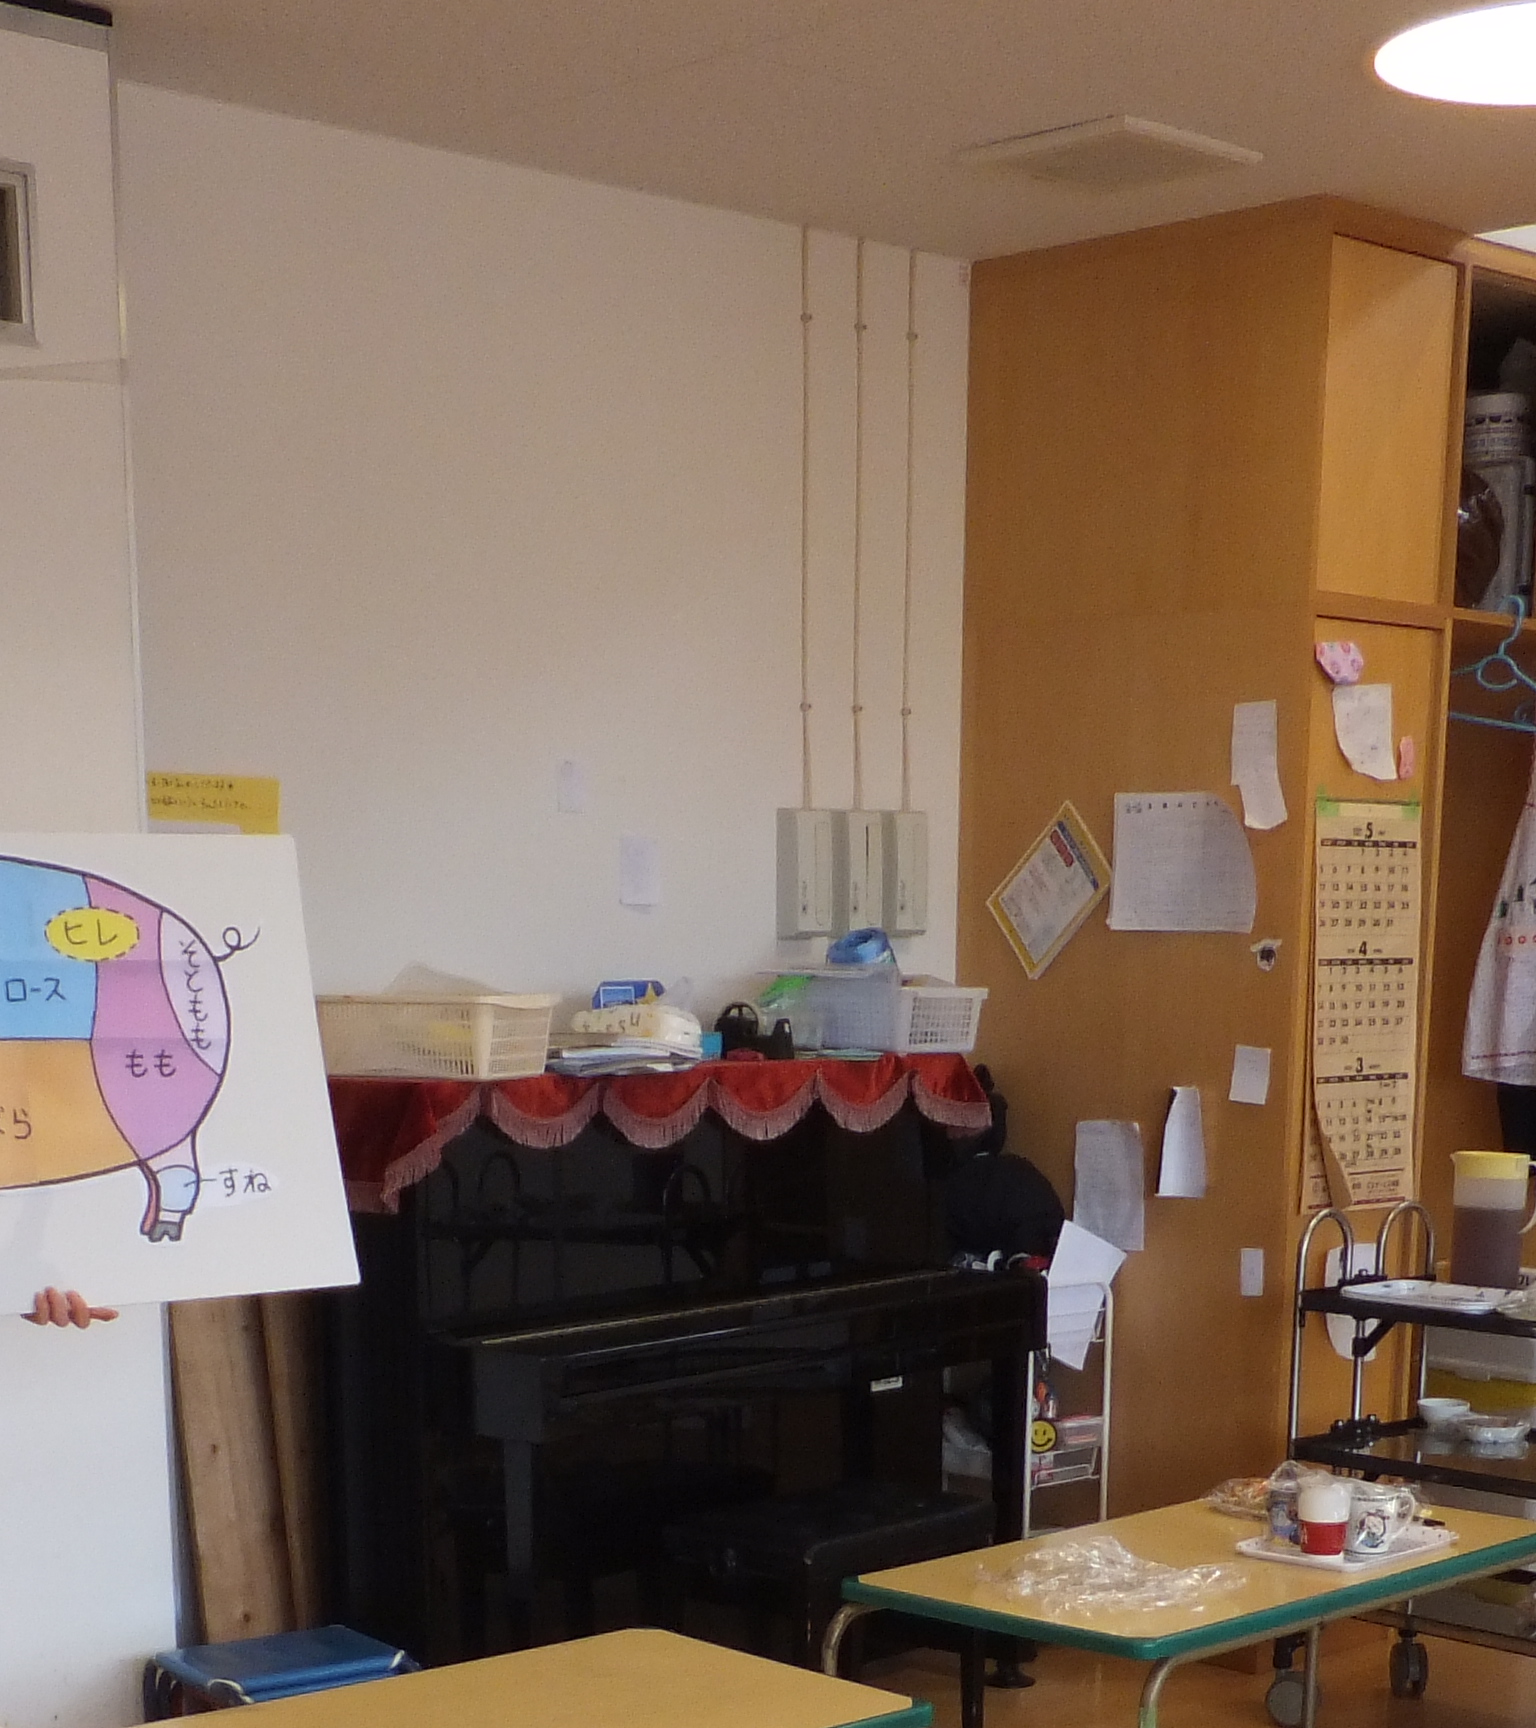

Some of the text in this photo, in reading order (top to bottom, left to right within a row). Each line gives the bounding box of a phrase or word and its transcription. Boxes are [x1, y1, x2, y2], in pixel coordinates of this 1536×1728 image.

[1365, 822, 1373, 839] 5
[64, 919, 118, 946] ヒレ
[1359, 941, 1367, 955] 4
[5, 978, 66, 1002] ロース
[178, 939, 212, 1051] そともも
[125, 1049, 177, 1078] もも
[1356, 1058, 1363, 1073] 3
[218, 1168, 273, 1197] すね
